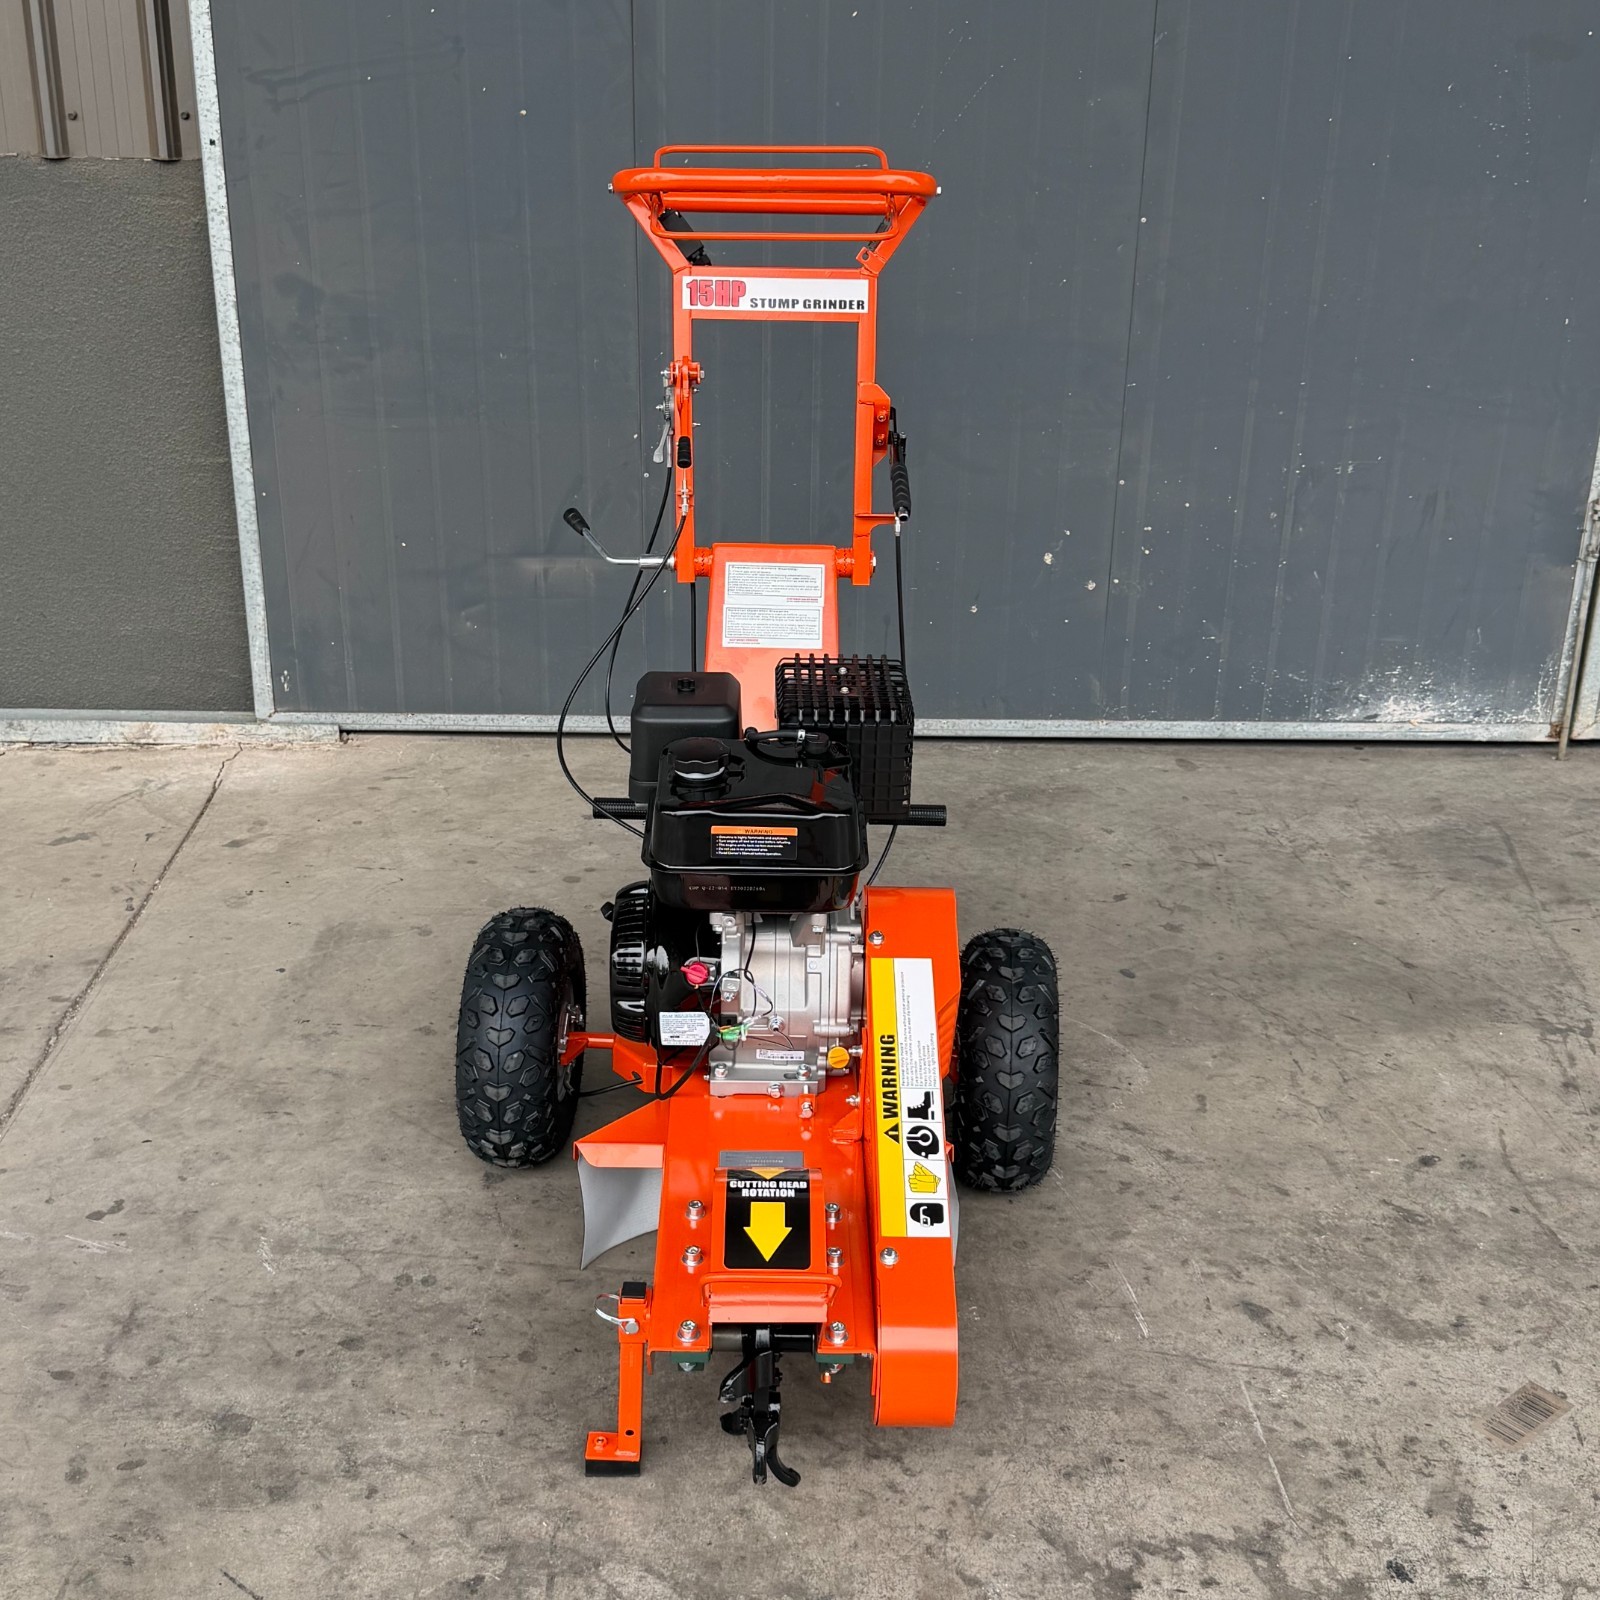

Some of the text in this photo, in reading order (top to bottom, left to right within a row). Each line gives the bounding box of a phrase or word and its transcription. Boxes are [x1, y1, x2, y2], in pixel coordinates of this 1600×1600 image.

[686, 279, 865, 310] 15HP STUMP GRINDER
[880, 1034, 899, 1119] WARNING
[729, 1180, 807, 1189] CUTTING HEAD
[741, 1188, 795, 1197] ROTATION
